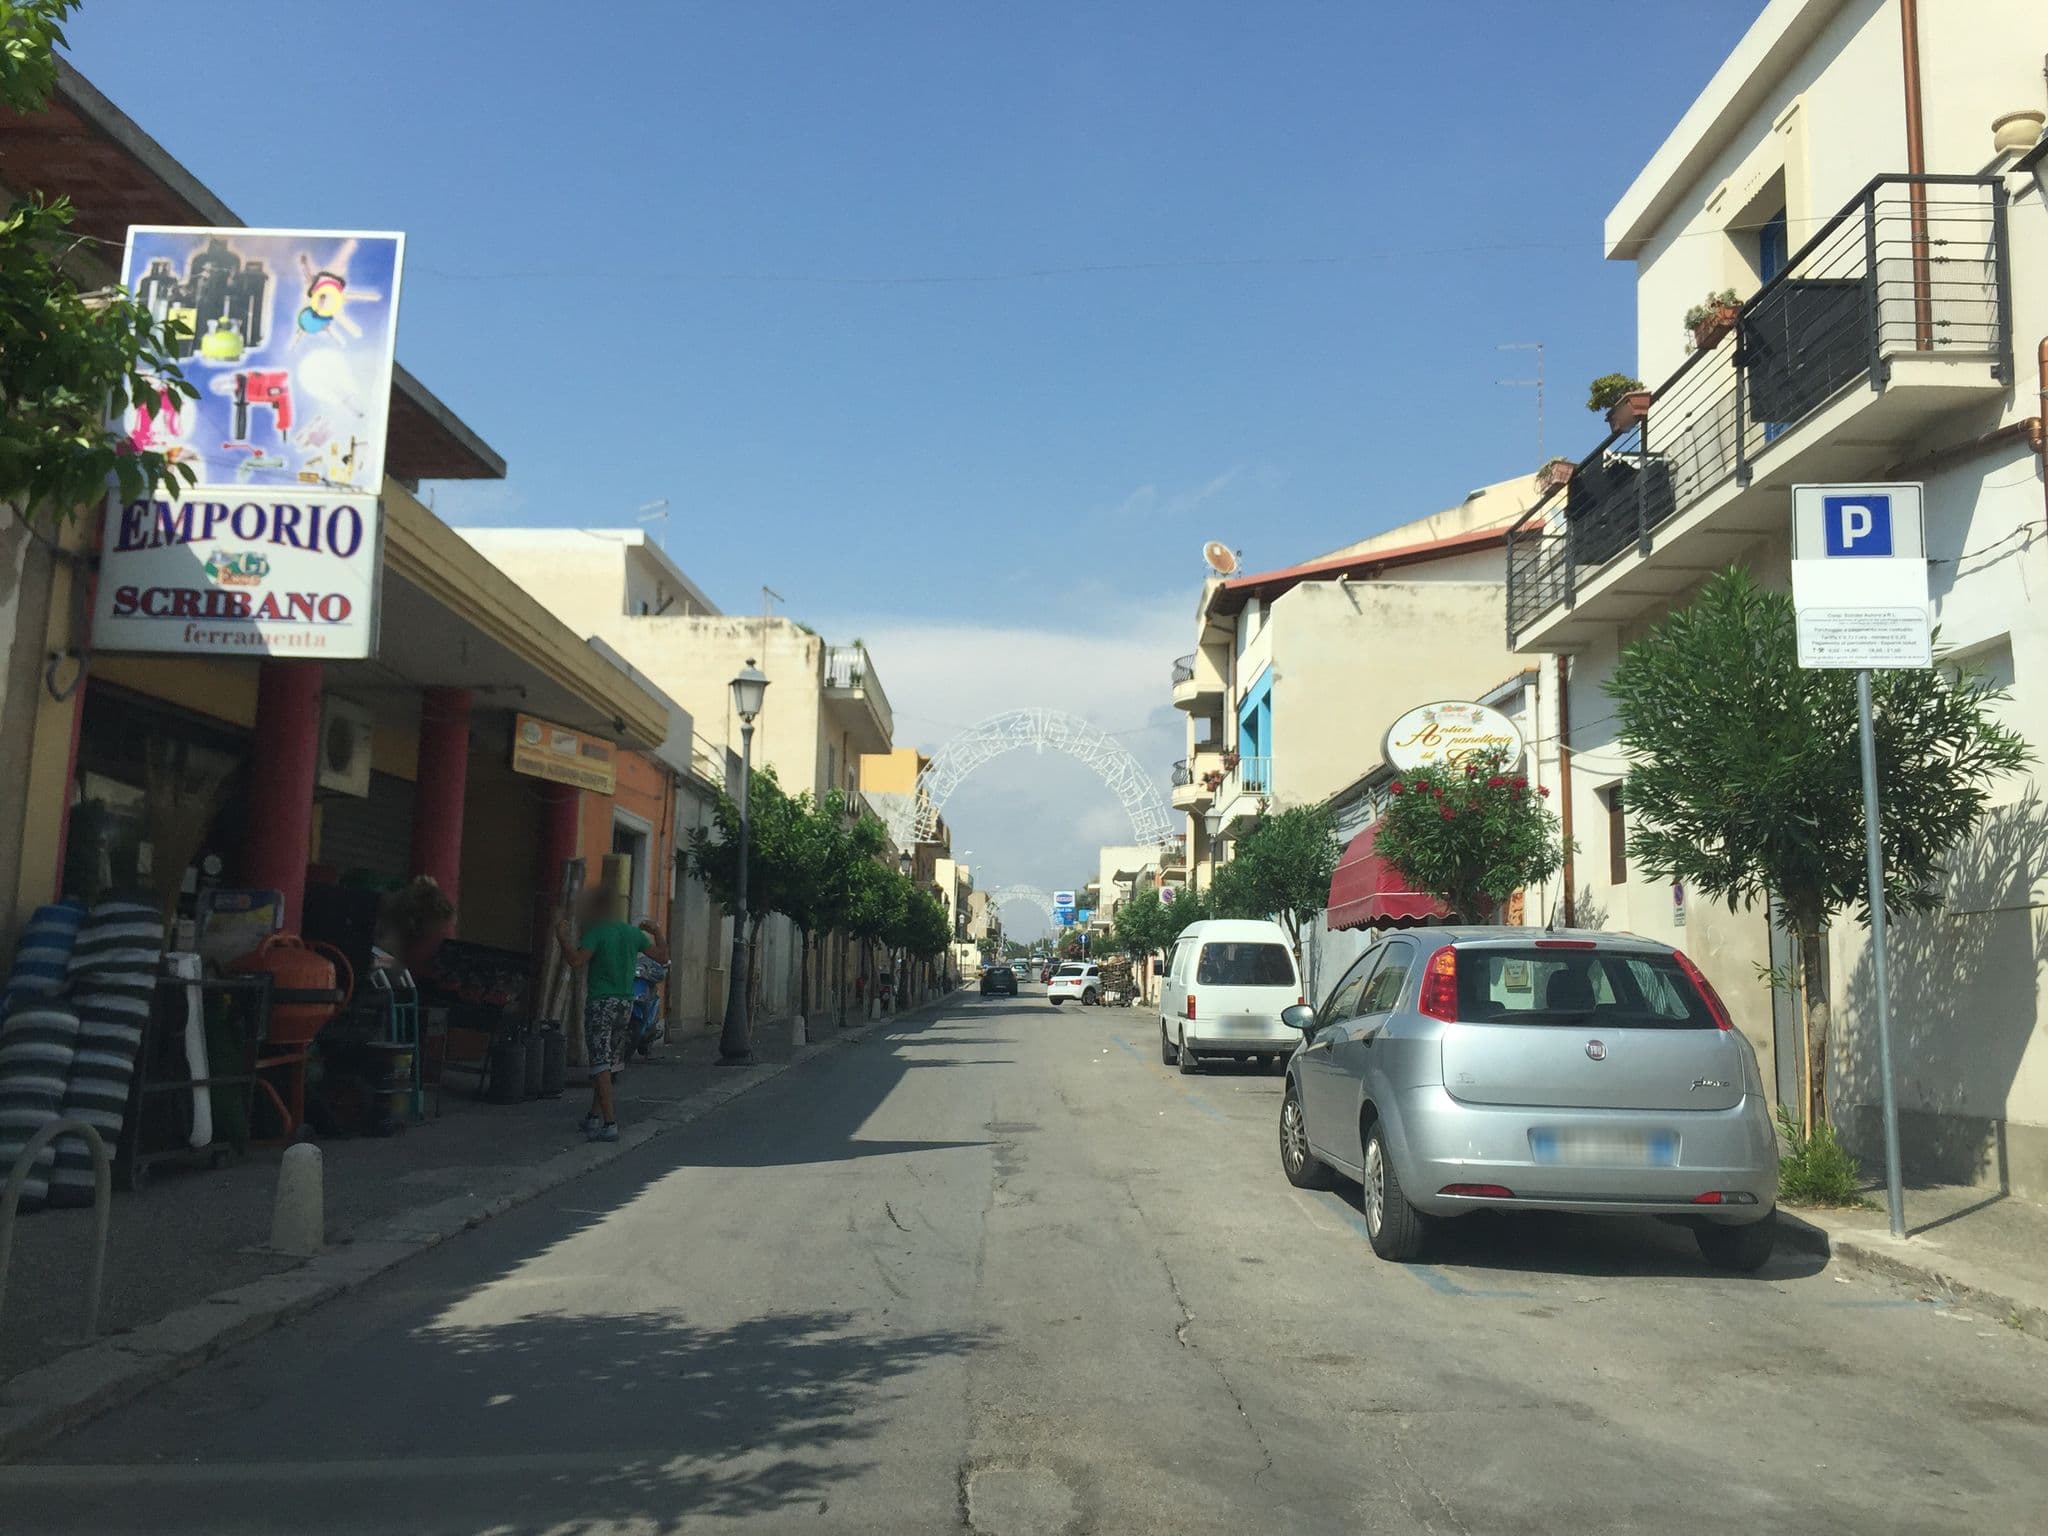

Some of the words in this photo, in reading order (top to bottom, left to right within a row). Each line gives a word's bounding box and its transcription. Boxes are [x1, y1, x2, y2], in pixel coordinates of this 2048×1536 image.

[113, 499, 363, 559] EMPORIO
[1841, 505, 1873, 548] P
[113, 585, 352, 622] SCRIBANO
[183, 622, 327, 648] ferramenta
